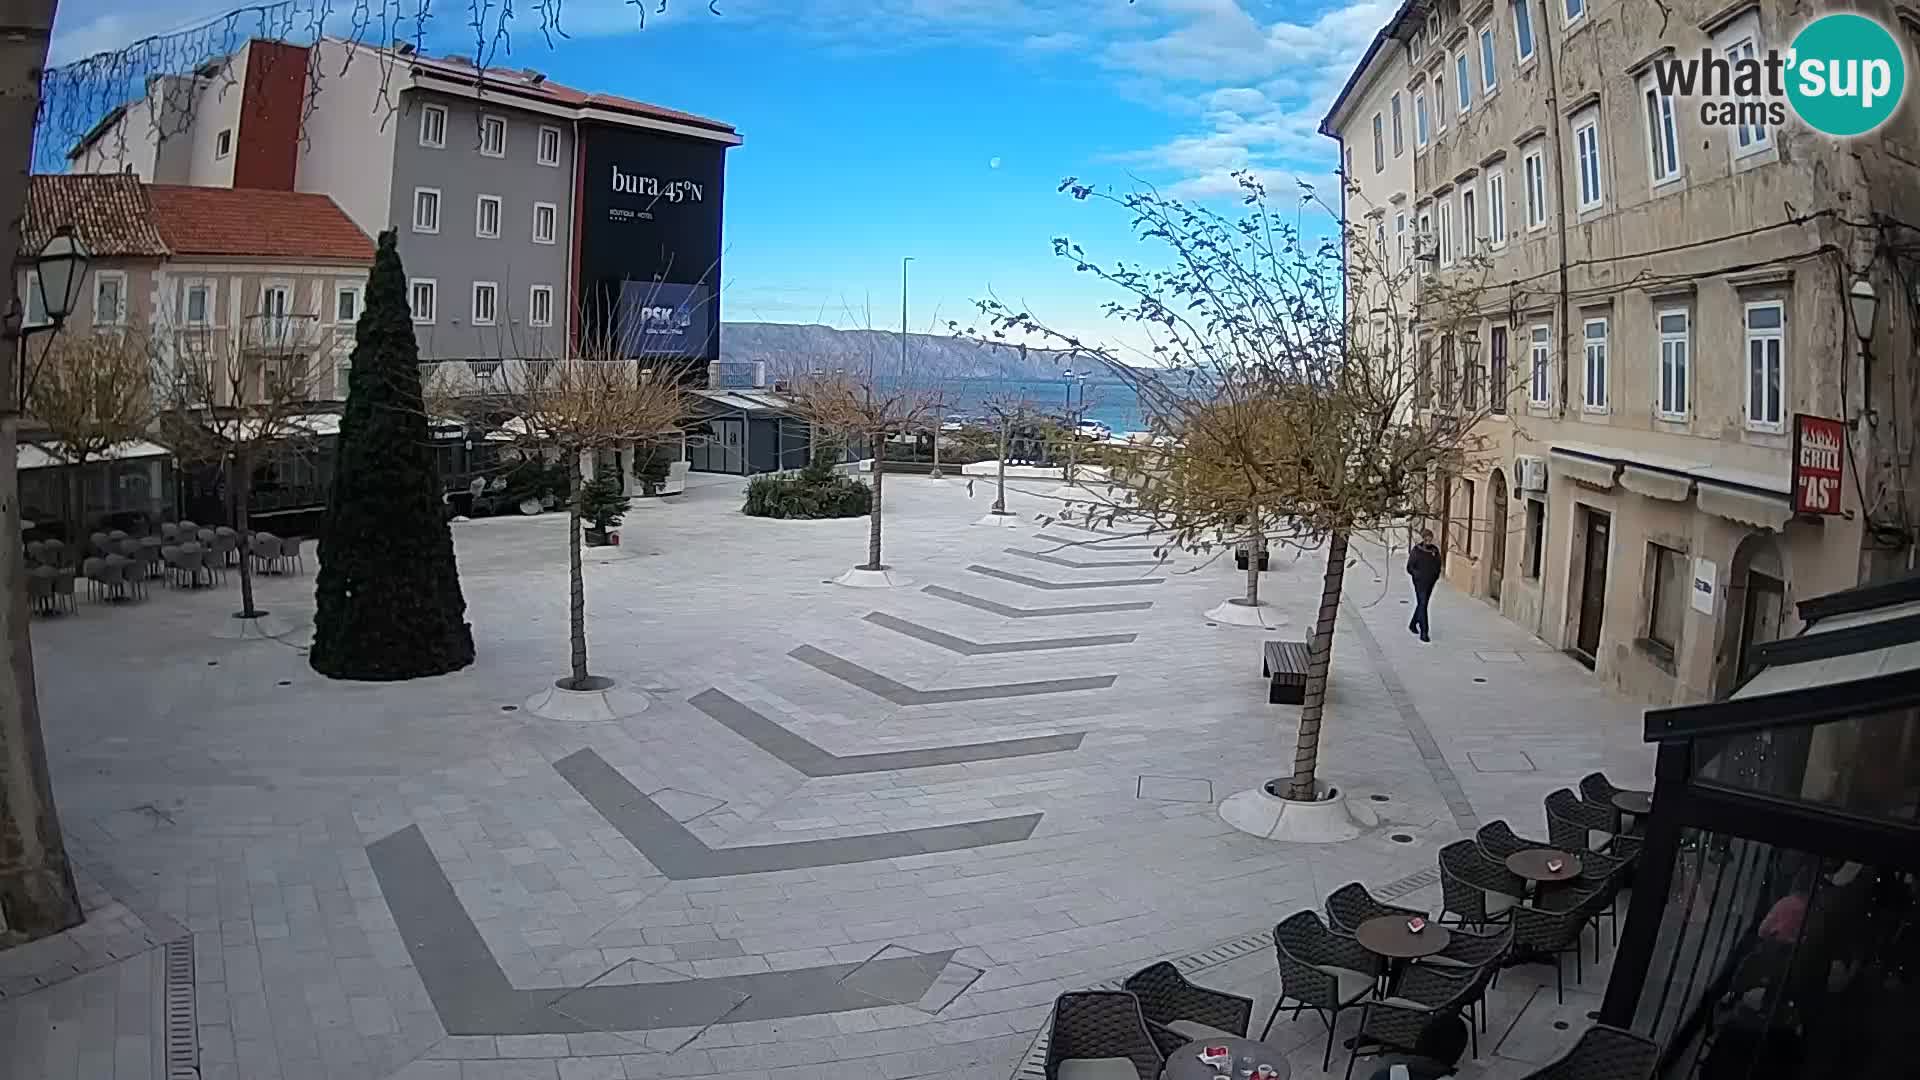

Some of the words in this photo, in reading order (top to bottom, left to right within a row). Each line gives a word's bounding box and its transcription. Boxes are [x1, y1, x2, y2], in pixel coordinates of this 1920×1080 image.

[612, 165, 658, 196] bura
[1800, 447, 1840, 472] GRILL
[1799, 475, 1839, 510] "AS"
